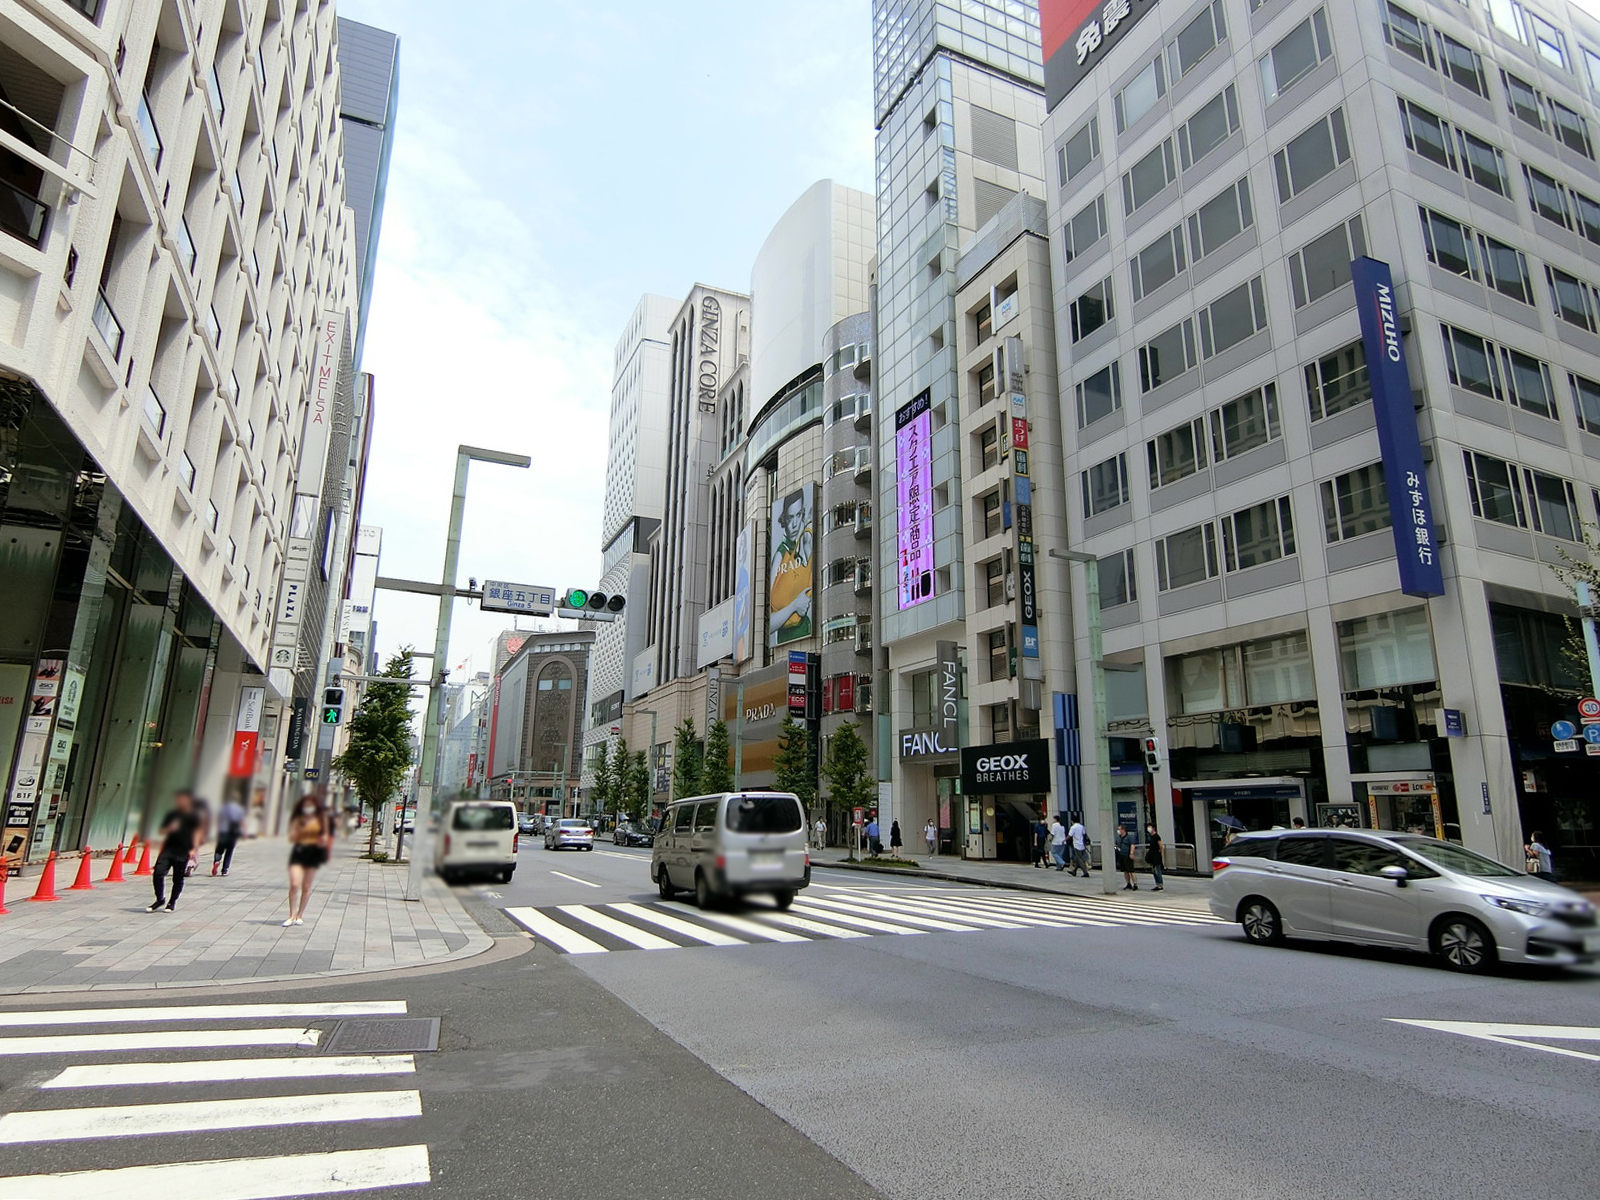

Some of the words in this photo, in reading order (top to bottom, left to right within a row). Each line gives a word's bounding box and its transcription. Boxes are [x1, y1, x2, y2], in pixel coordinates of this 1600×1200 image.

[701, 296, 720, 355] GINZA
[1376, 282, 1400, 362] MIZUHO
[313, 321, 337, 424] EXITMELSA
[699, 360, 718, 414] CORE
[1406, 471, 1432, 566] みずほ銀行
[285, 584, 298, 618] PLAZA
[489, 587, 551, 605] 銀座五丁目
[507, 600, 525, 609] Ginza
[1023, 570, 1033, 619] GEOX
[707, 678, 718, 714] GINZA
[746, 702, 777, 721] PRADA
[943, 661, 957, 728] FANCL
[1584, 703, 1598, 713] 30
[244, 700, 256, 730] SoftBank
[292, 707, 303, 749] WASHINGTON
[1588, 729, 1599, 742] P
[976, 754, 1028, 772] GEOX
[976, 770, 1029, 782] BREATHES
